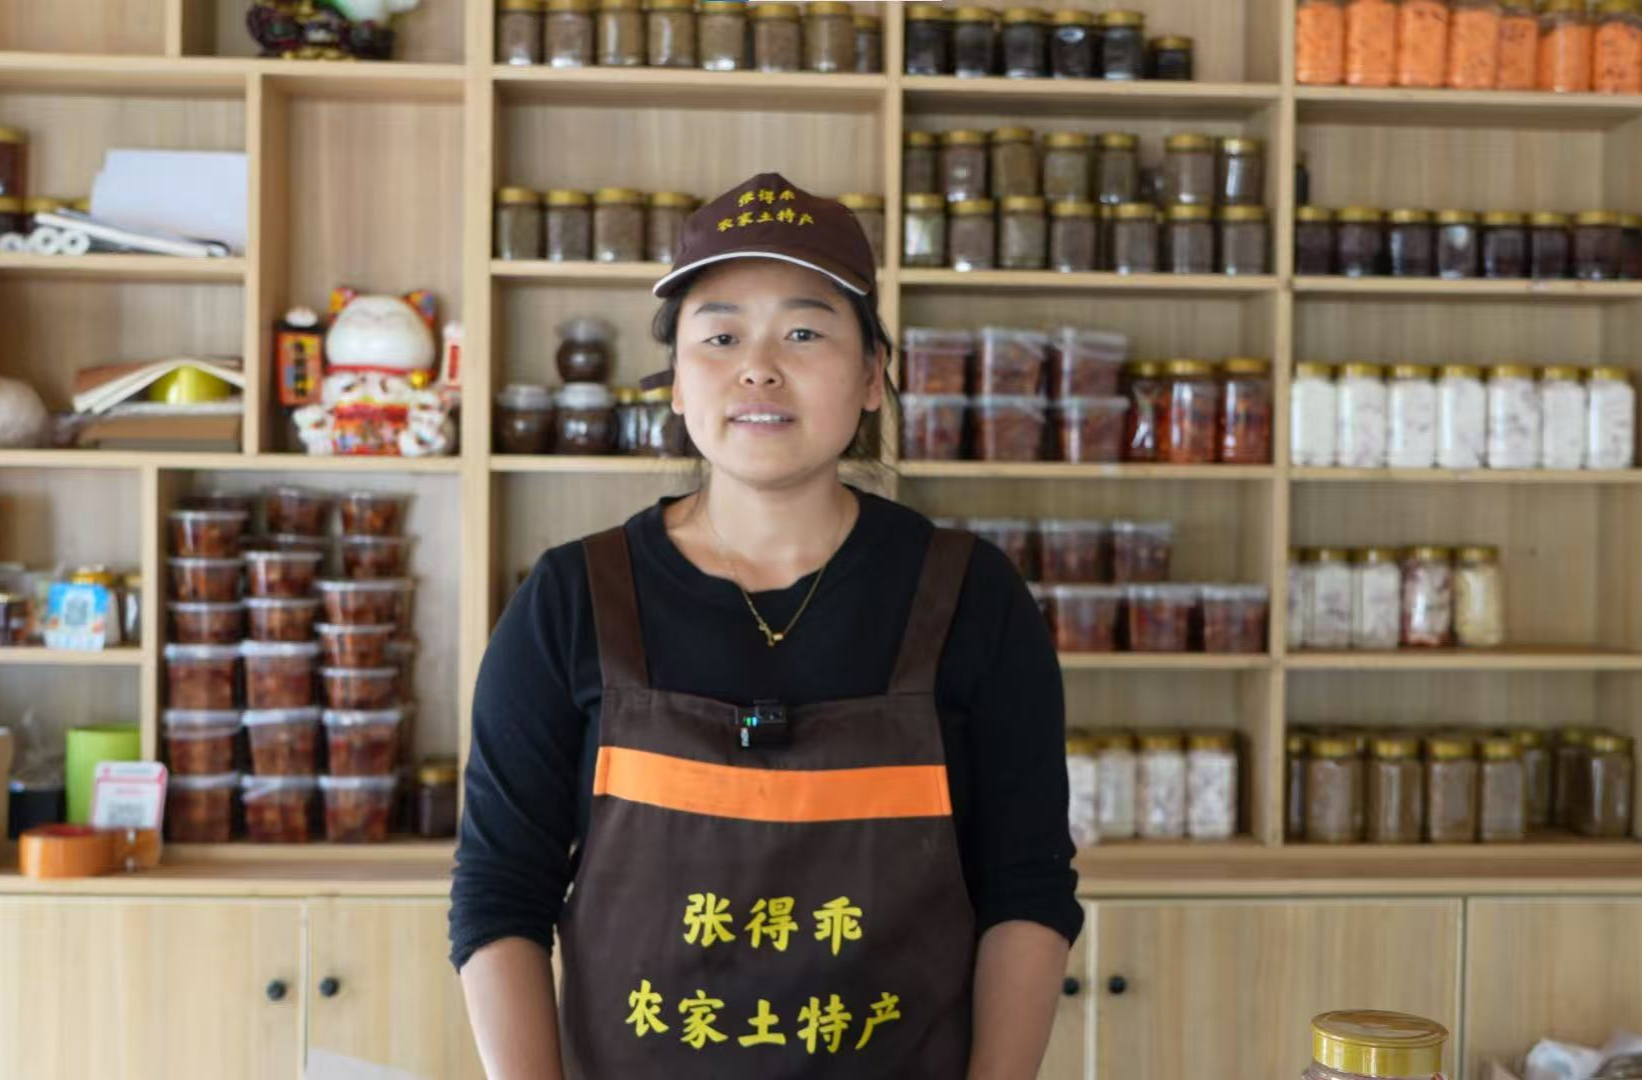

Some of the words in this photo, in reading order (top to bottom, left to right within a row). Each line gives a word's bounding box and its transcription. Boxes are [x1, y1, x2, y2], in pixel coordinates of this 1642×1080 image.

[682, 892, 863, 956] 张得乖
[625, 979, 902, 1054] 农家土特产
